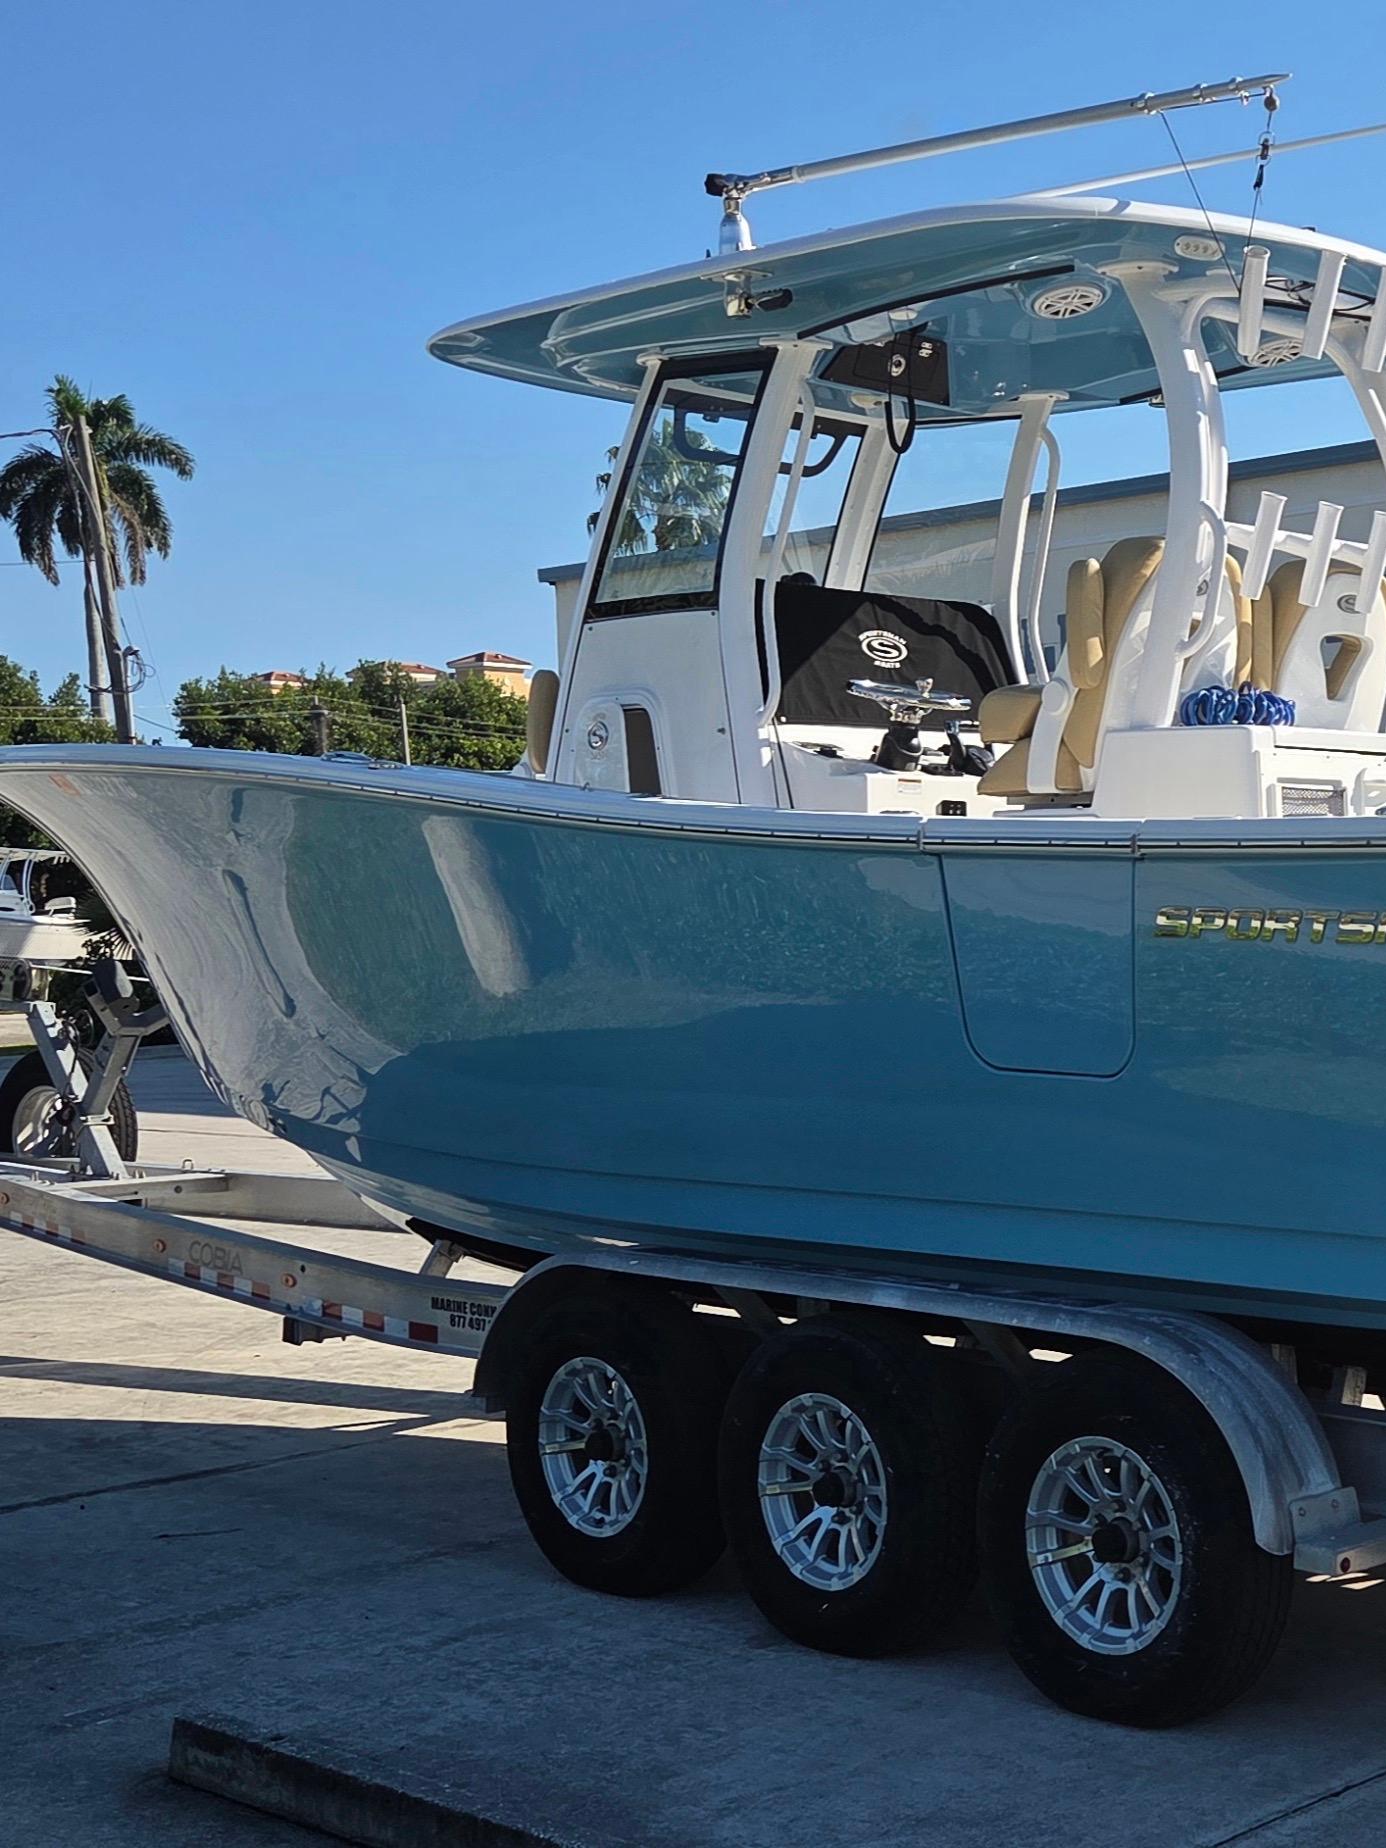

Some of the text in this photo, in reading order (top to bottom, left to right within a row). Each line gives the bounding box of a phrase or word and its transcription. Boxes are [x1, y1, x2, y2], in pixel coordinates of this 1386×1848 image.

[188, 1240, 244, 1275] COBIA
[431, 1296, 468, 1315] MARINE
[449, 1313, 487, 1332] 877 497
